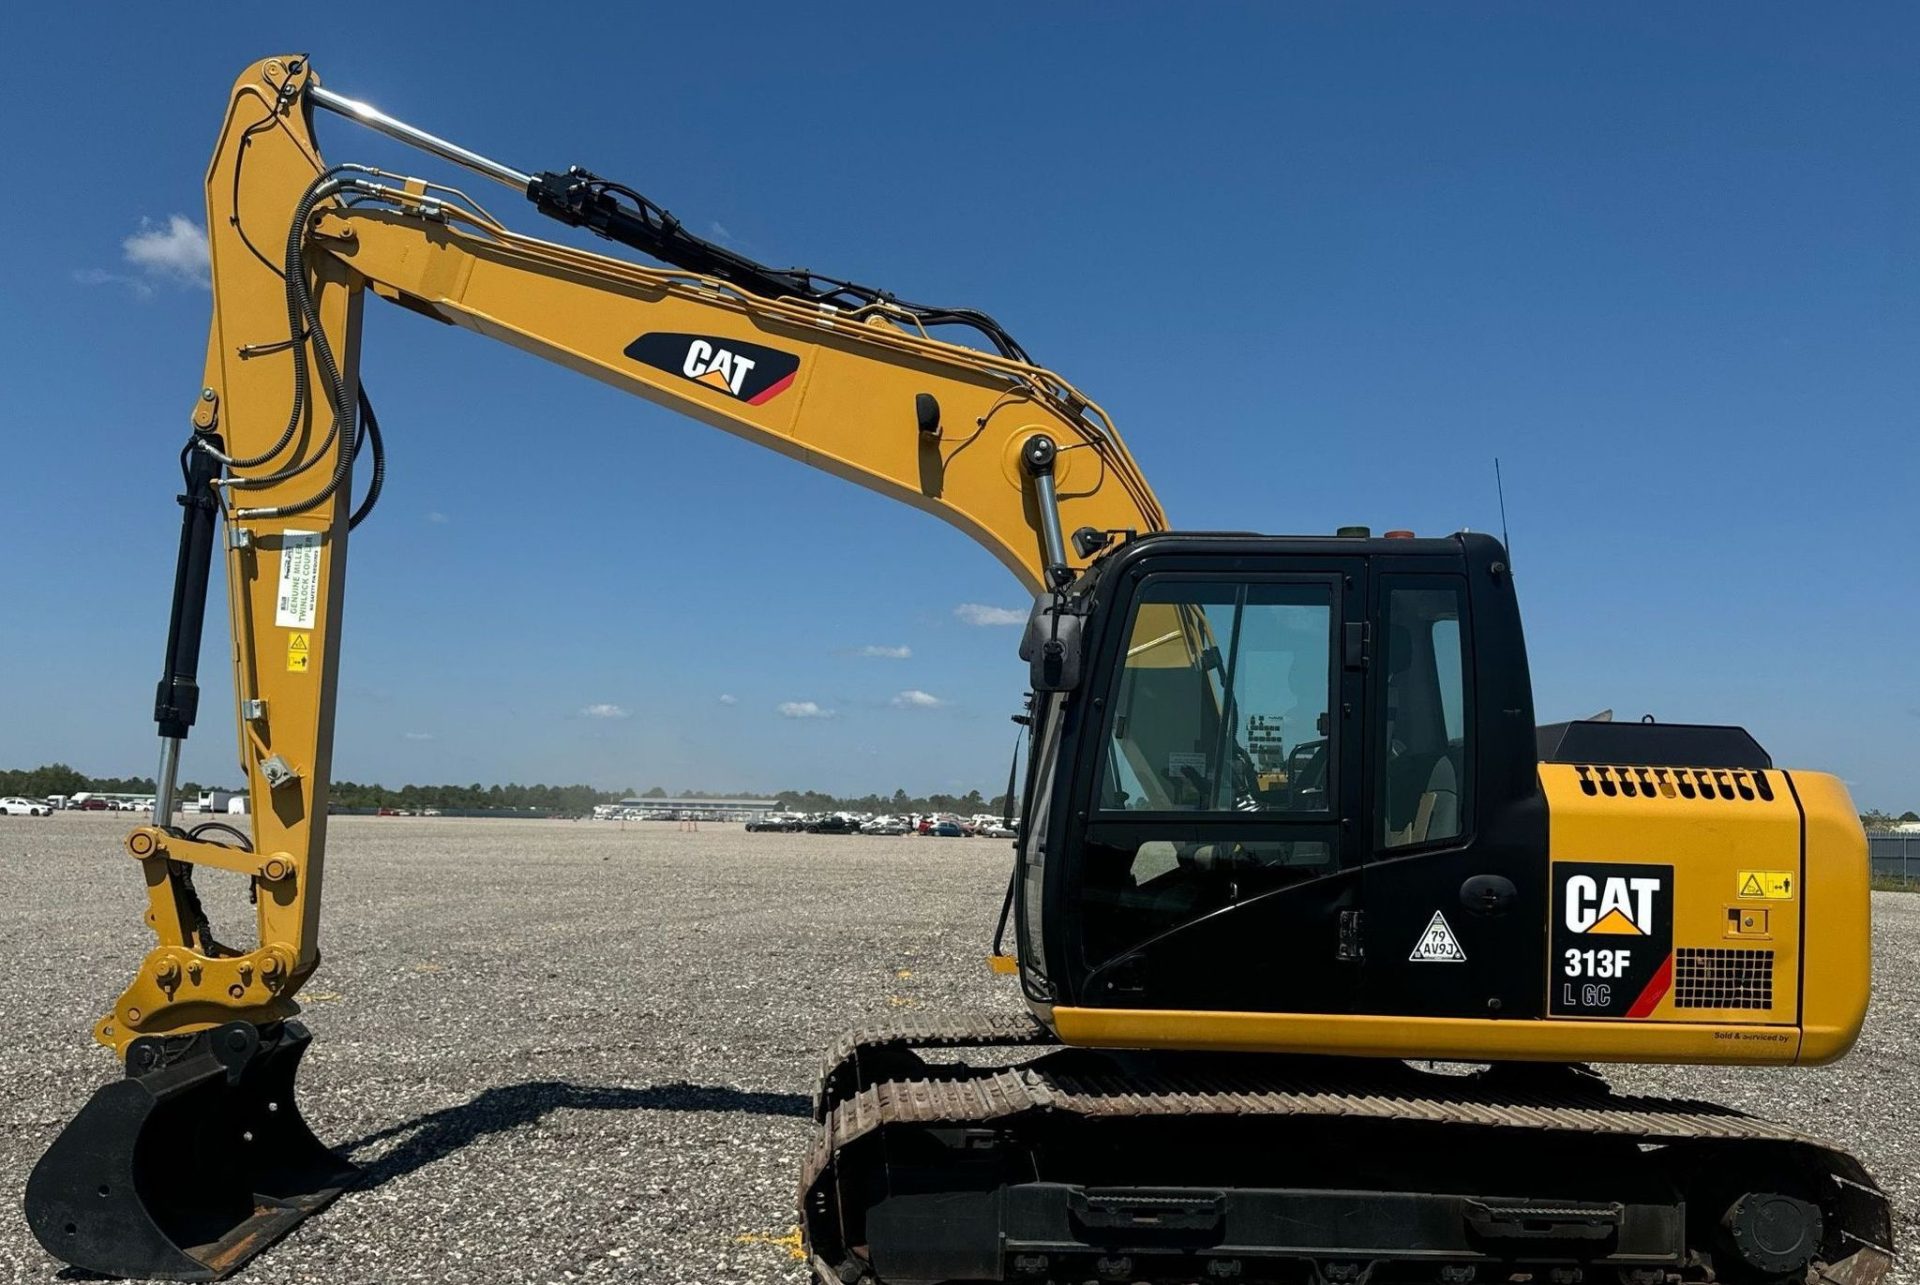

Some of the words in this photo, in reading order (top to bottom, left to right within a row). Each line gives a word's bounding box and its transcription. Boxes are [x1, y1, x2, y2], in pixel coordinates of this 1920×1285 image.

[683, 339, 756, 396] CAT
[294, 543, 303, 574] MILLER
[302, 536, 313, 576] COUPLER
[290, 577, 300, 614] GENUINE
[298, 578, 309, 622] TWINLOCK
[1566, 875, 1660, 936] CAT
[1423, 943, 1454, 955] AV9J
[1431, 930, 1446, 942] 79
[1564, 948, 1631, 978] 313F
[1563, 983, 1576, 1006] L
[1582, 983, 1611, 1007] GC
